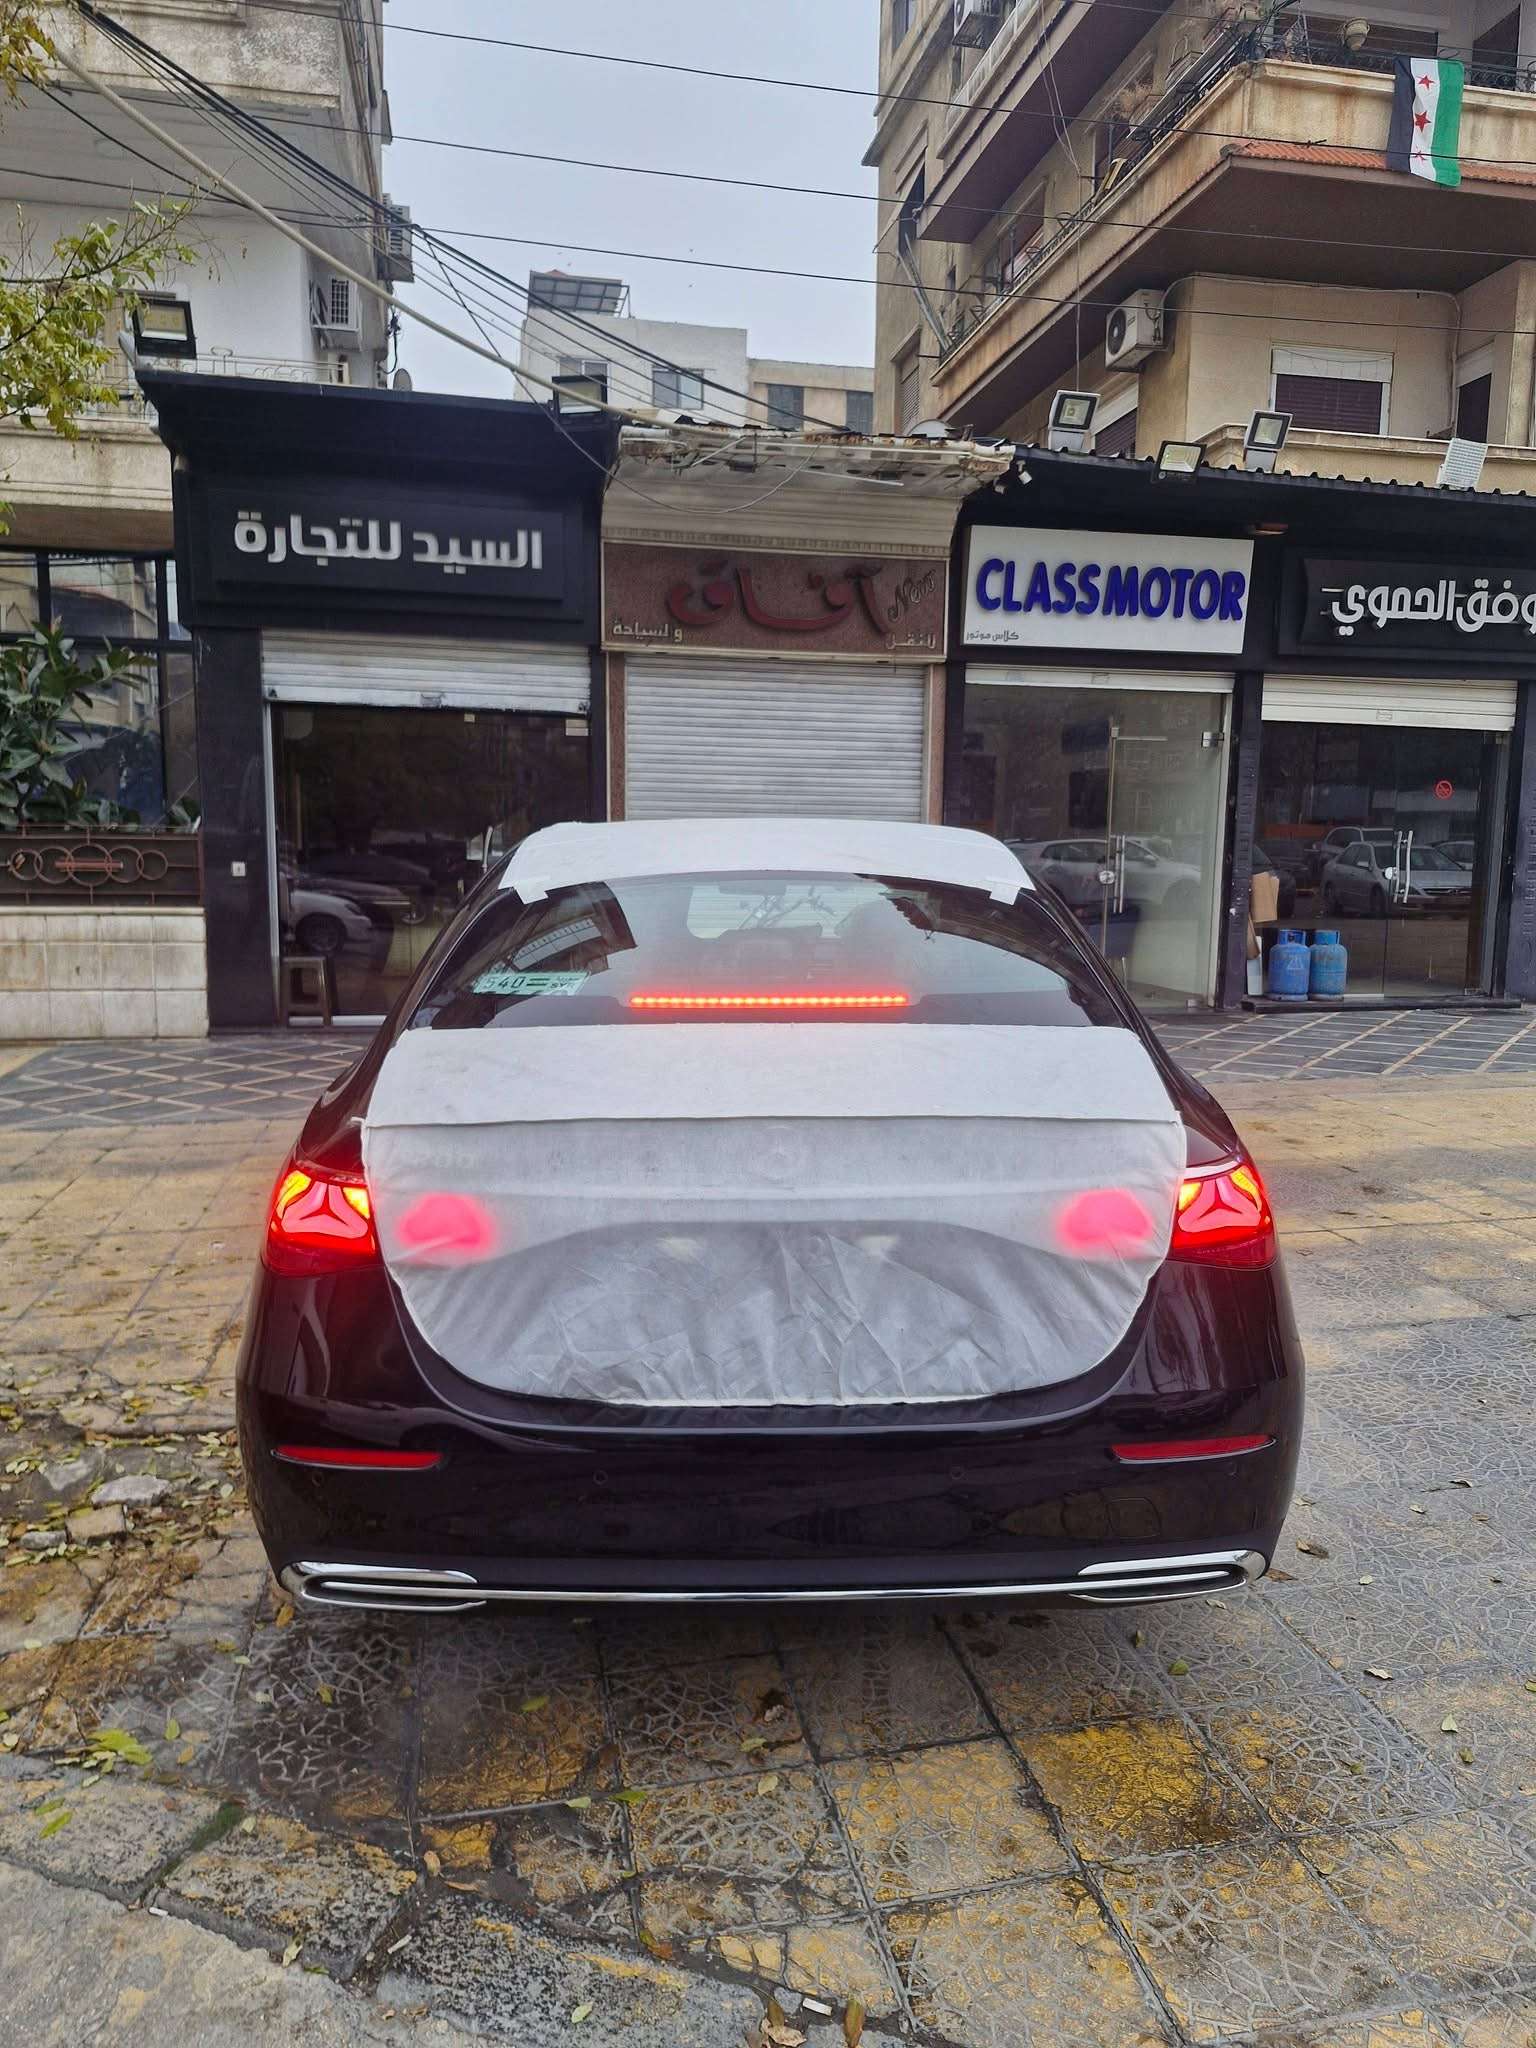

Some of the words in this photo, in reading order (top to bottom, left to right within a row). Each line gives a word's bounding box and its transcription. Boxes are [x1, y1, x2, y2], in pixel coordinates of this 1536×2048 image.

[233, 510, 402, 566] للتجارة
[413, 528, 543, 574] السيد
[976, 558, 1246, 621] CLASSMOTOR
[1332, 579, 1456, 636] الحموي
[1456, 578, 1536, 635] وفق
[966, 630, 991, 641] موتور
[992, 630, 1020, 642] كلاس
